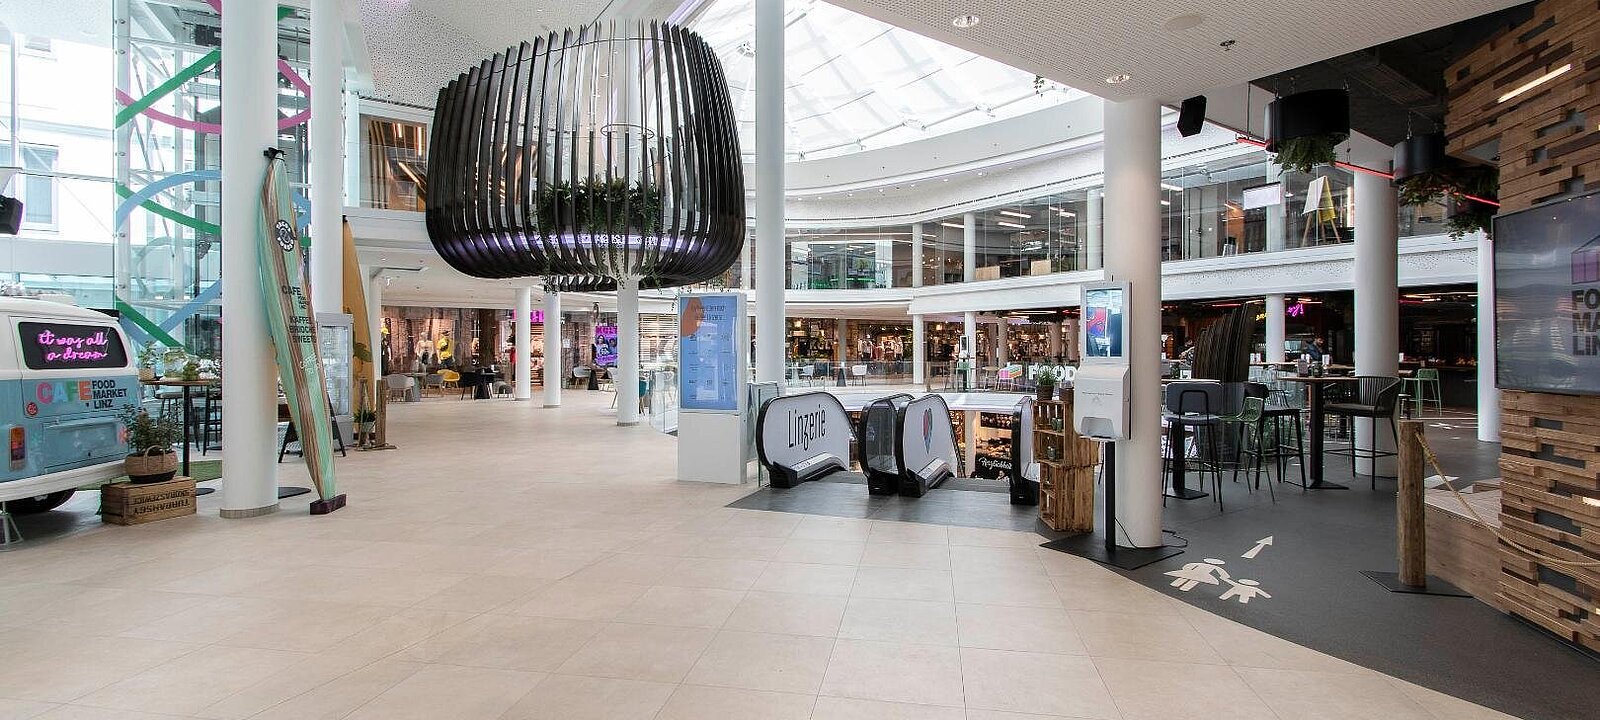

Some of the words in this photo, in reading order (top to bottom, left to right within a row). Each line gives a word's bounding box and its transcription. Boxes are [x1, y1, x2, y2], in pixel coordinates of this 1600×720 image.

[86, 332, 109, 346] all
[63, 346, 108, 360] dream
[92, 380, 116, 390] FOOD
[36, 380, 93, 404] CAFE
[93, 388, 128, 400] MARKET
[94, 400, 114, 410] LINZ
